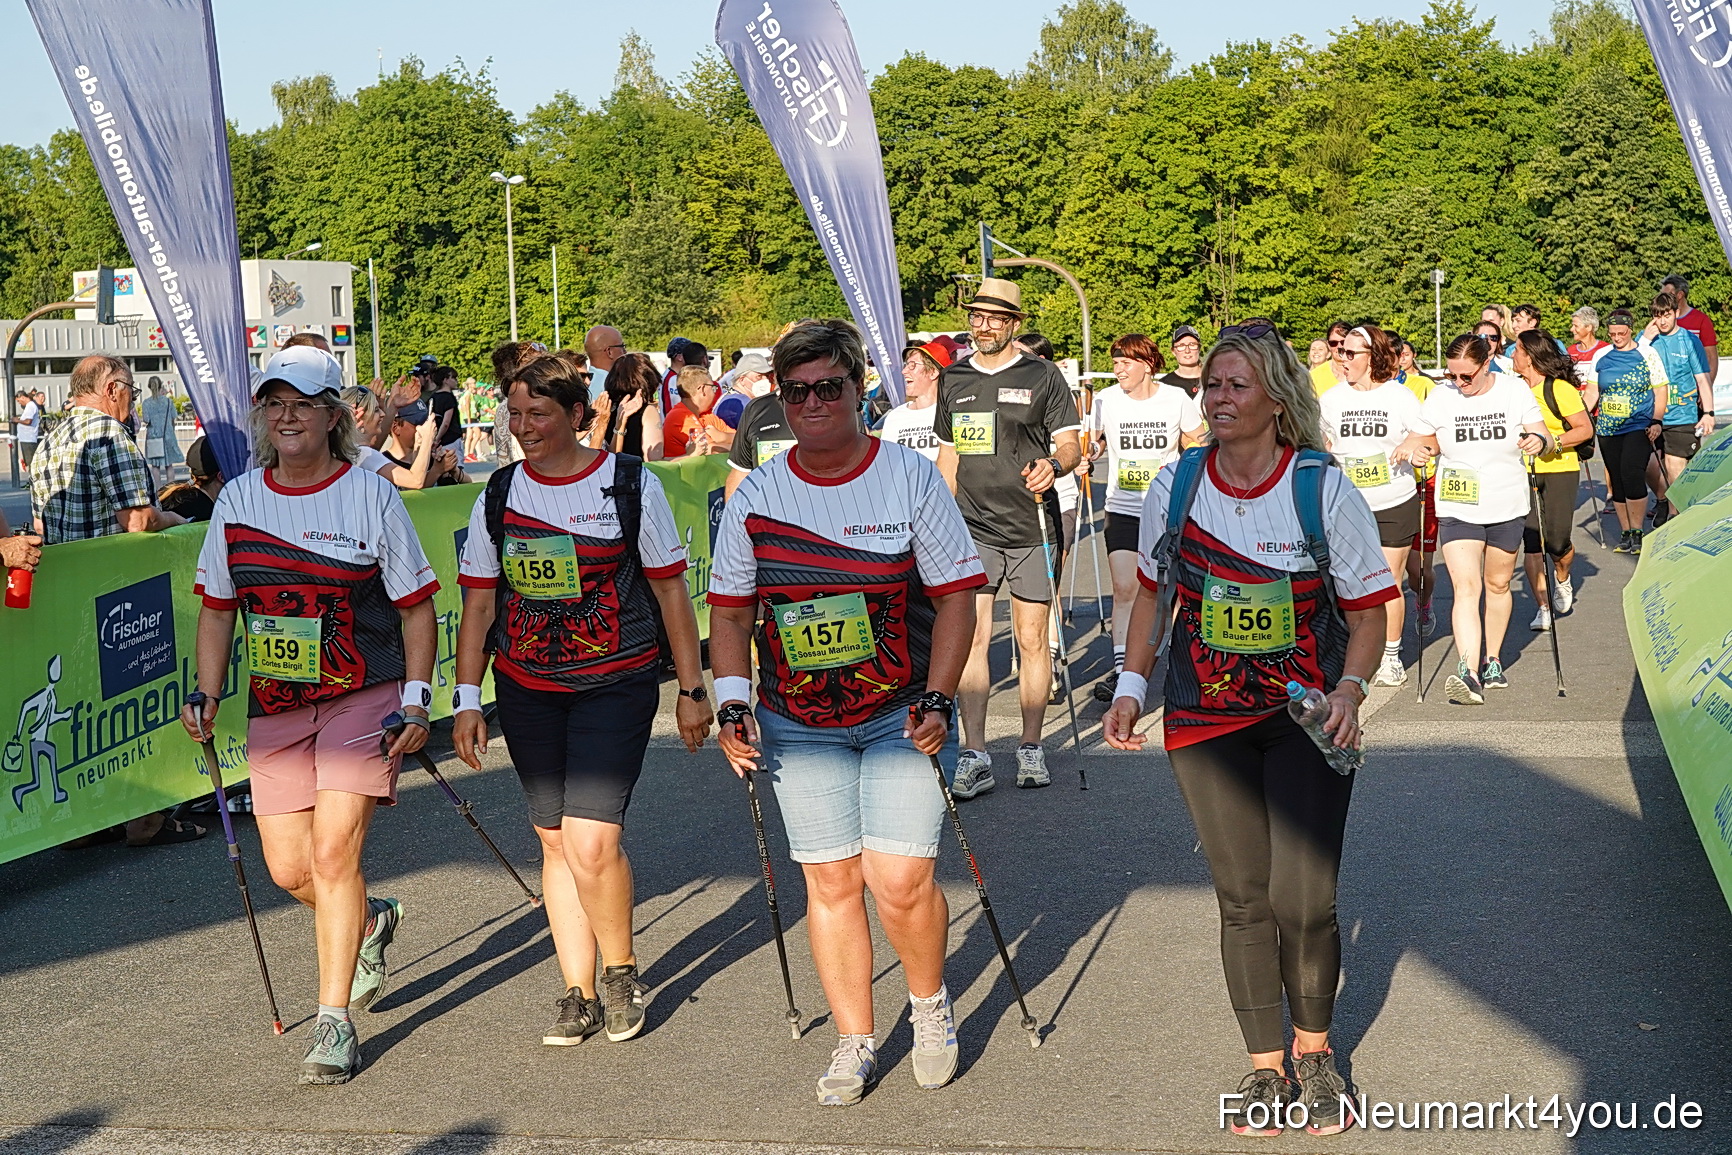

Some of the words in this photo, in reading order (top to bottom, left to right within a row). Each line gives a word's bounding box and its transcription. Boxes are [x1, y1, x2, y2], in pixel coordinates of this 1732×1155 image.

[1341, 410, 1388, 418] UMKEHREN
[1607, 403, 1622, 411] 682
[1120, 421, 1167, 429] UMKEHREN
[1455, 412, 1506, 423] UMKEHREN
[898, 425, 933, 434] UMKEHR
[961, 427, 985, 441] 422
[1340, 422, 1388, 437] BLÖD
[1455, 426, 1506, 443] BLÖD
[1120, 434, 1168, 450] BLÖD
[1127, 470, 1150, 482] 638
[1356, 466, 1379, 479] 584
[1448, 480, 1467, 491] 581
[569, 512, 619, 524] NEUMARKT
[843, 522, 906, 536] NEUMARKT
[303, 531, 357, 549] NEUMARKT
[1257, 541, 1304, 553] NEUMAR
[955, 554, 980, 566] www.neu
[518, 560, 556, 579] 158
[565, 560, 576, 589] 2022
[1361, 567, 1391, 582] www.neu
[515, 580, 531, 588] Wehr
[1206, 604, 1214, 638] WALK
[1223, 606, 1272, 631] 156
[1283, 606, 1291, 640] 2022
[112, 611, 162, 642] Fischer
[802, 620, 845, 647] 157
[118, 628, 160, 651] AUTOMOBILE
[857, 620, 871, 651] 2022
[1223, 631, 1249, 640] Bauer
[263, 637, 299, 660] 159
[785, 631, 799, 662] WALK
[798, 649, 827, 658] Sossau
[828, 643, 861, 655] Martina
[261, 658, 282, 667] Cortes
[282, 661, 303, 672] Birgit
[308, 644, 316, 674] 2022
[77, 736, 153, 790] neumarkt
